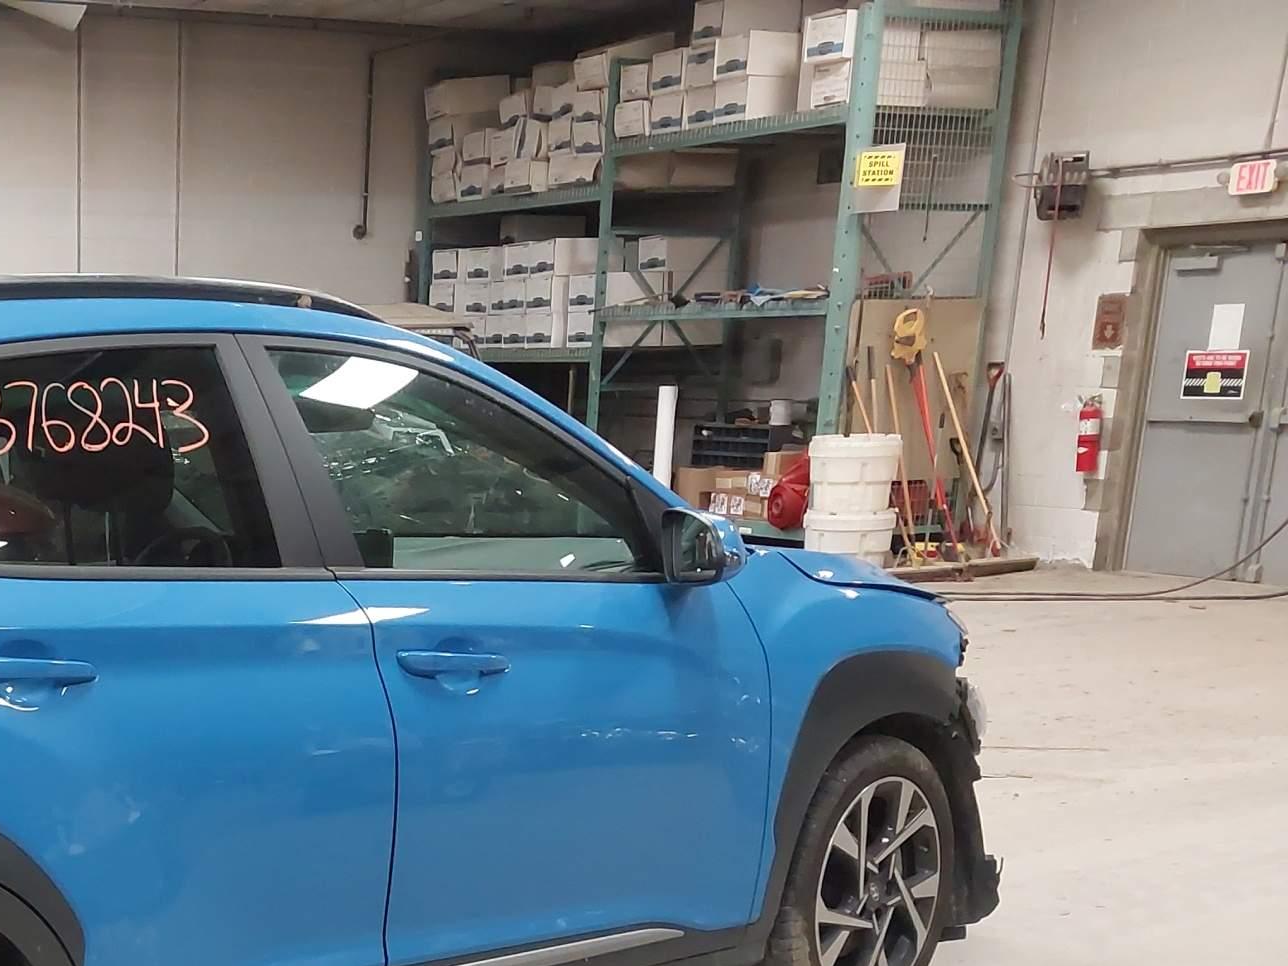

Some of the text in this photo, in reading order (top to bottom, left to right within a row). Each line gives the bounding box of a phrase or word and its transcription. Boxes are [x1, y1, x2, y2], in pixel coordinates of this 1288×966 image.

[868, 160, 890, 168] SPILL
[862, 169, 894, 177] STATION
[1236, 161, 1271, 192] EXIT
